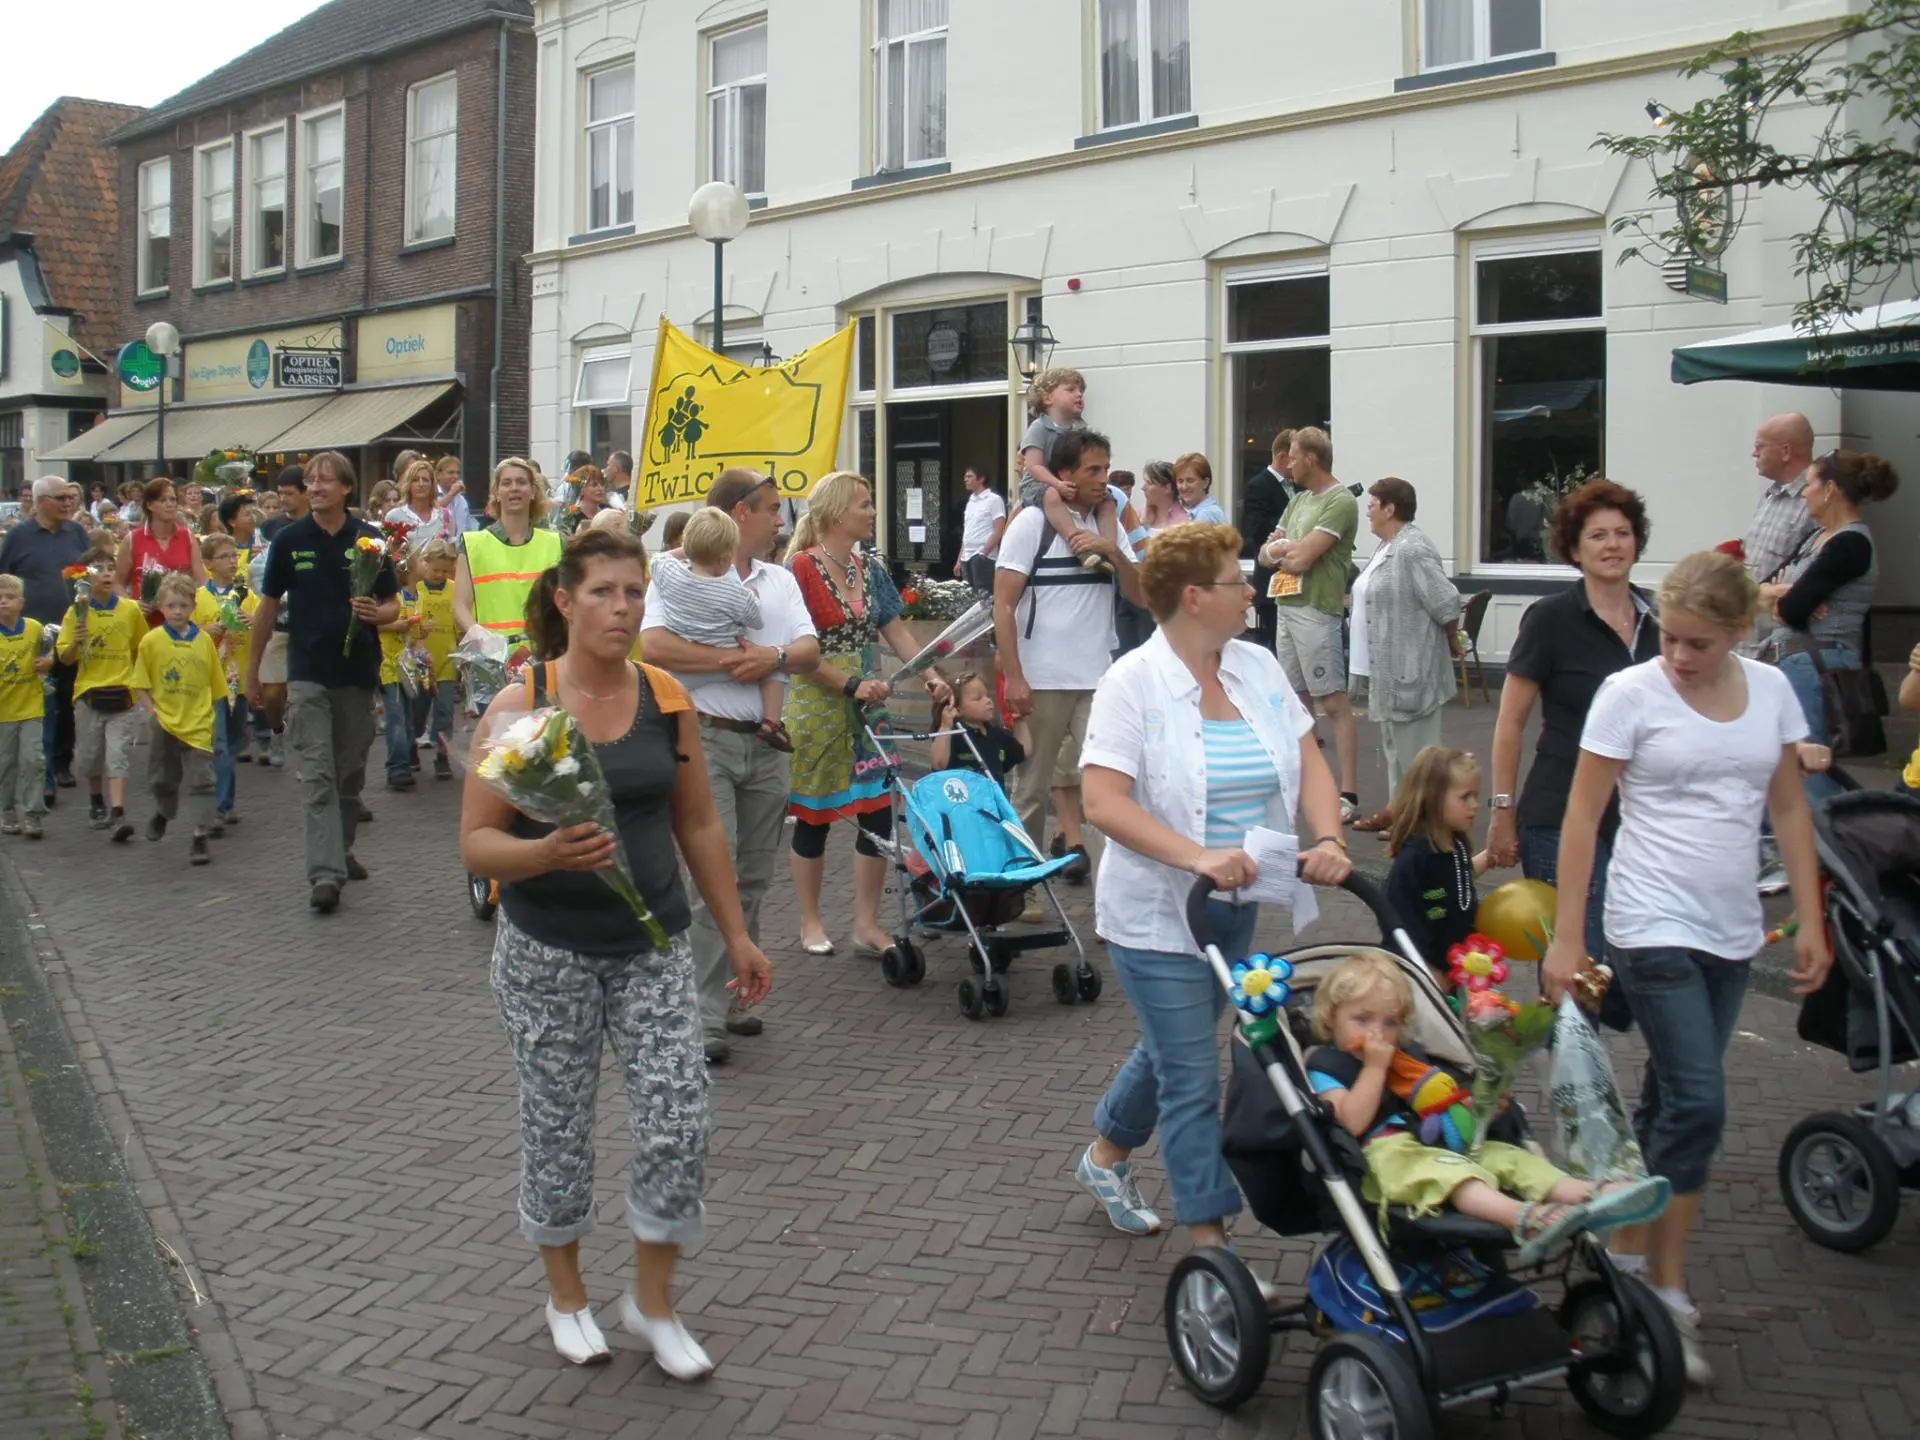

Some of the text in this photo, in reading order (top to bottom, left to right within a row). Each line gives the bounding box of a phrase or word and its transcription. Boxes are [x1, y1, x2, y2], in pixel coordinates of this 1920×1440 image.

[385, 334, 425, 359] Optiek
[1889, 341, 1901, 354] IS
[289, 356, 331, 368] OPTIEK
[288, 374, 334, 385] AARSEN
[644, 460, 809, 504] Twiclo
